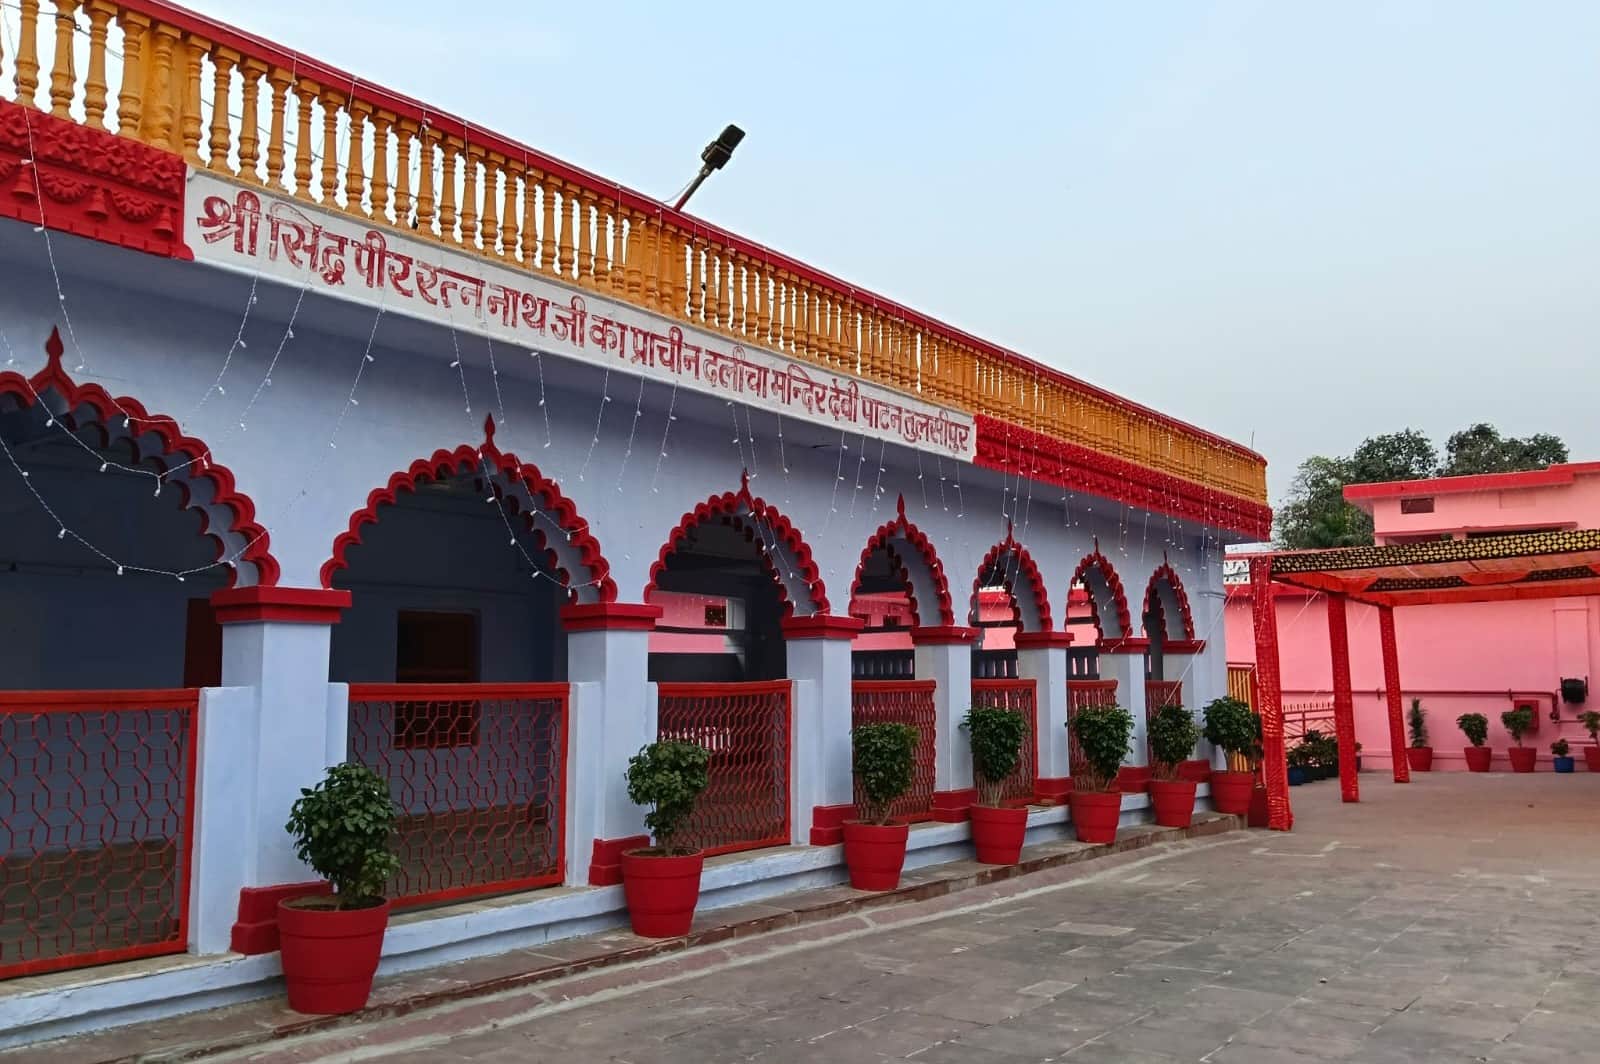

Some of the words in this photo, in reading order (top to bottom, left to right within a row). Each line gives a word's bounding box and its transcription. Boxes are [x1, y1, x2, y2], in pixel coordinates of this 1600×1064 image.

[196, 190, 262, 257] श्री
[551, 295, 588, 348] जी
[589, 314, 628, 359] का
[631, 325, 702, 380] प्राचीन
[703, 345, 769, 399] दलीचा
[771, 363, 829, 415] मन्दिर
